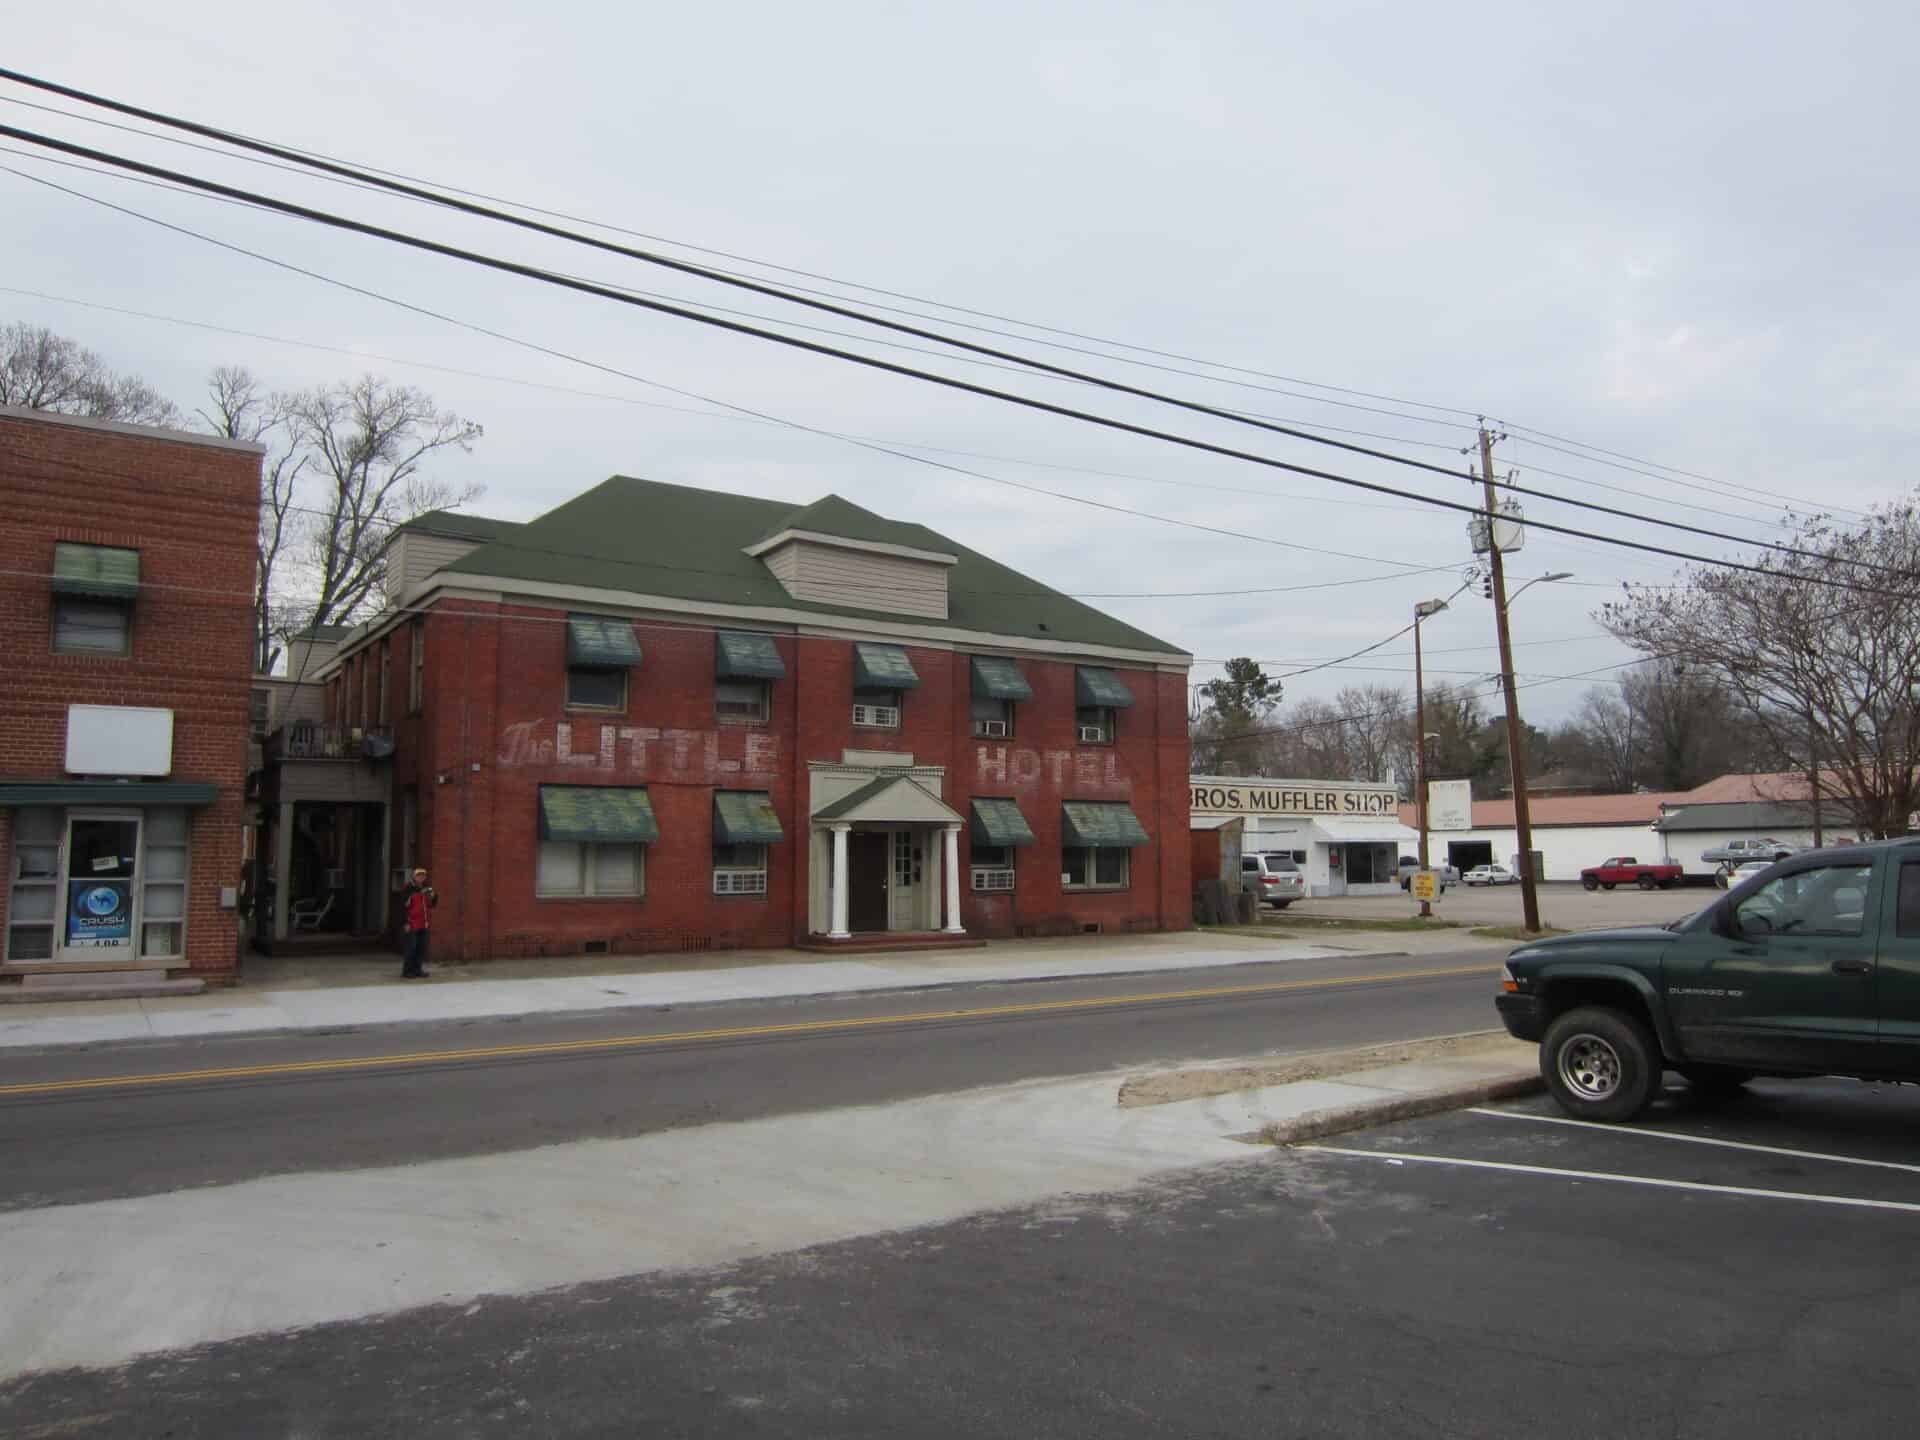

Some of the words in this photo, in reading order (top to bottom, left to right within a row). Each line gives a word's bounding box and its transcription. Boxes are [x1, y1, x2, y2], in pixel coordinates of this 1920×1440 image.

[496, 718, 553, 768] The
[556, 721, 780, 777] LITTLE
[975, 745, 1132, 791] HOTEL
[1190, 788, 1244, 809] ROS.
[1249, 790, 1338, 812] MUFFLER
[1343, 792, 1395, 812] SHOP
